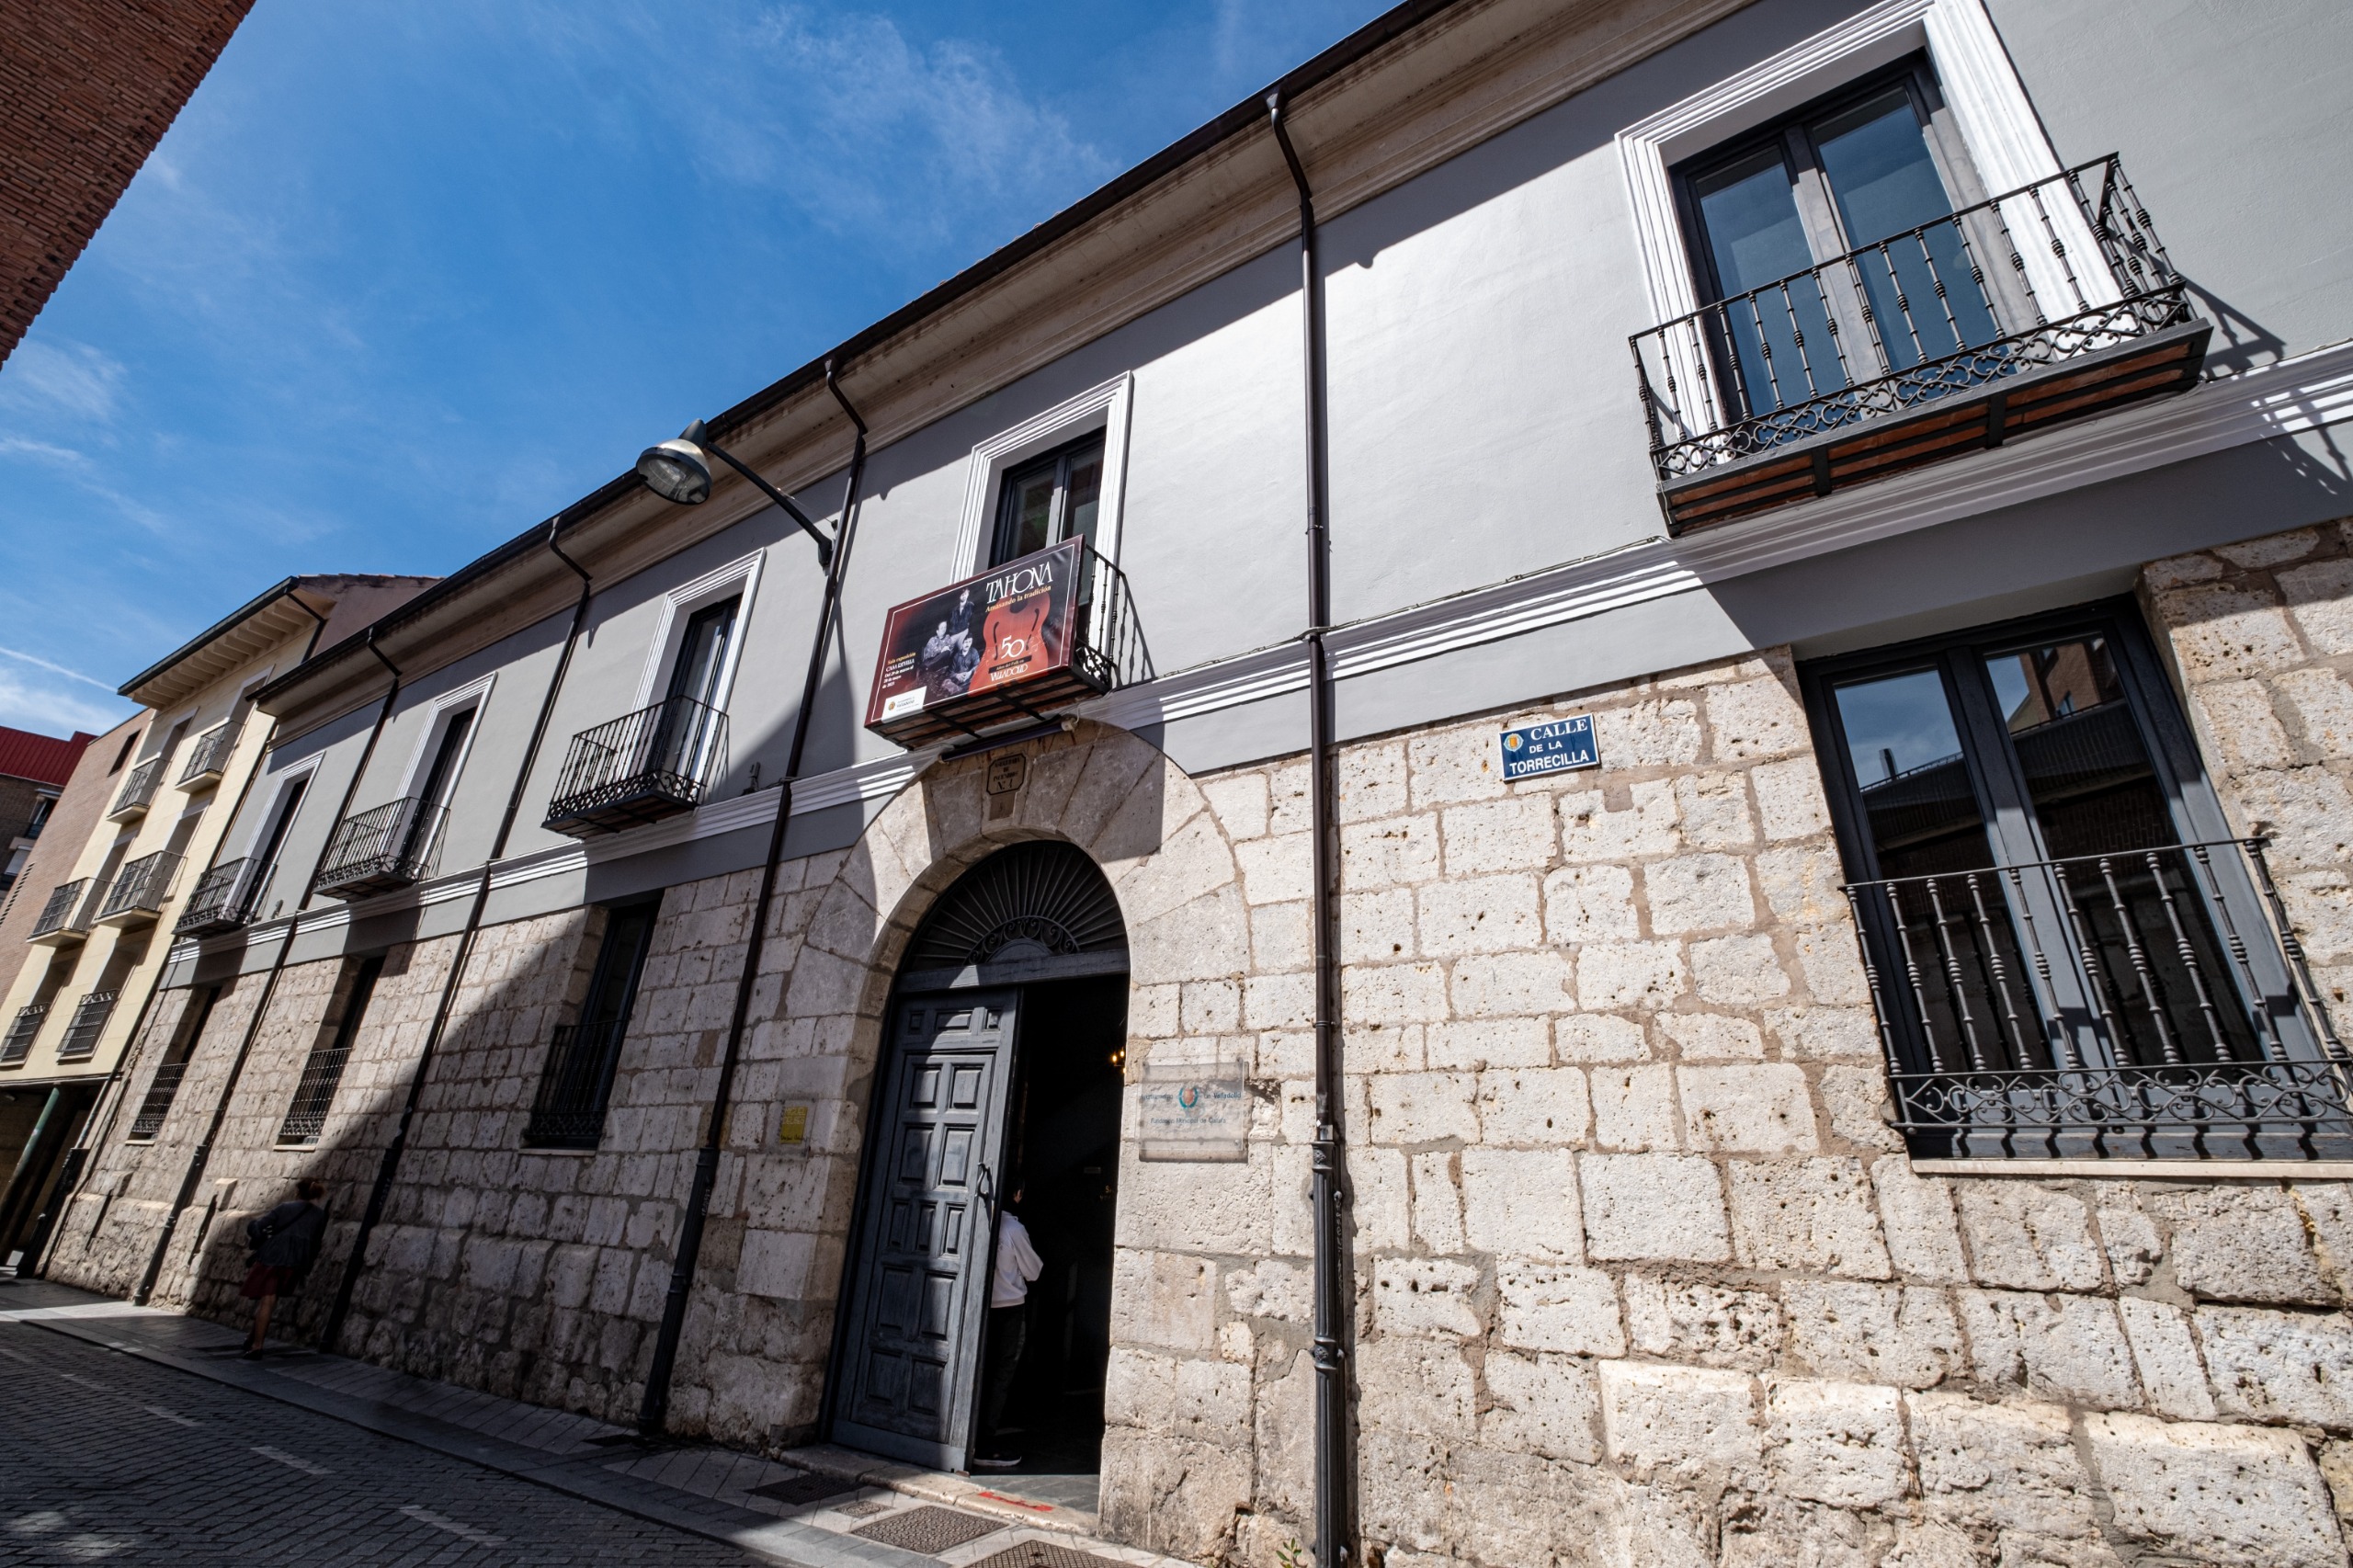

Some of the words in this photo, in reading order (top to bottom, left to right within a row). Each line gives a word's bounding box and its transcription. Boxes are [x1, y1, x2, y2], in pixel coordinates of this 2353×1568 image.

[985, 562, 1053, 604] TAHONA
[985, 596, 1017, 613] Amasando
[1024, 585, 1051, 600] tradición
[1001, 635, 1025, 659] 50
[990, 664, 1029, 682] VALLADOLID
[1530, 719, 1588, 741] CALLE
[1529, 744, 1543, 754] DE
[1548, 741, 1563, 750] LA
[1509, 750, 1589, 775] TORRECILLA
[1213, 1091, 1241, 1099] Valladolid
